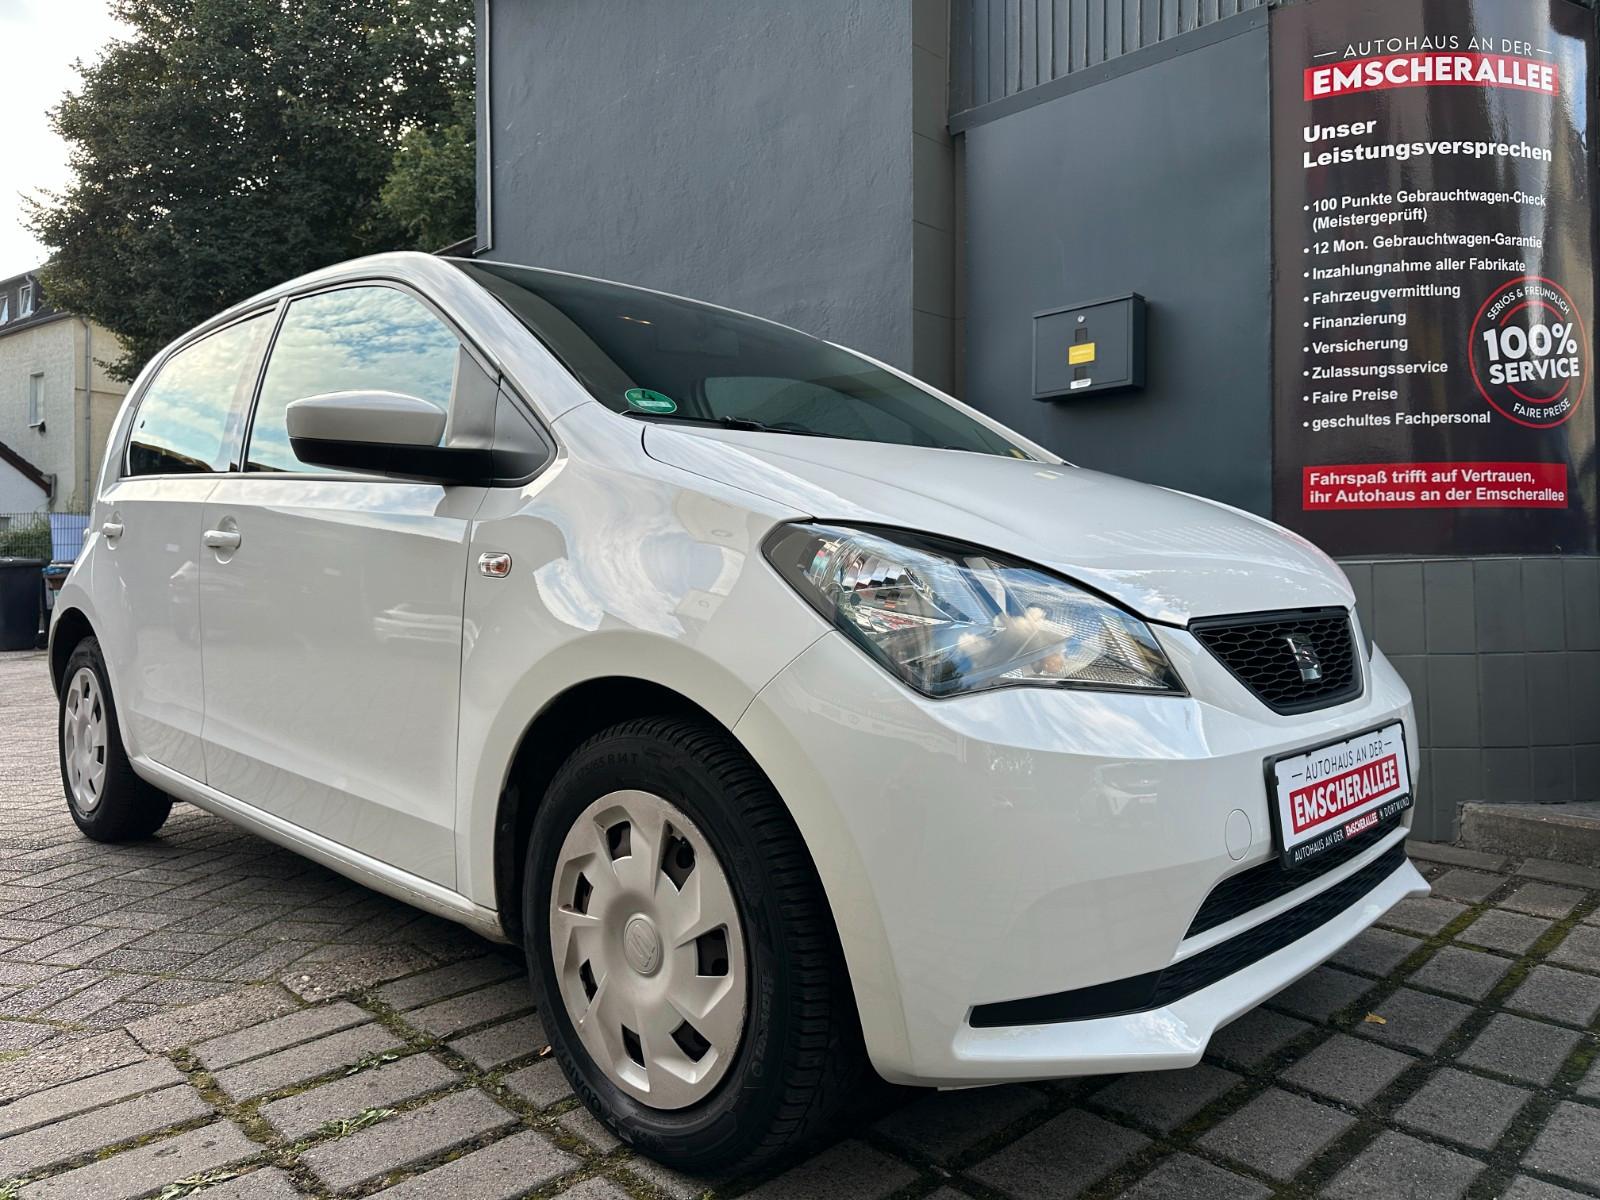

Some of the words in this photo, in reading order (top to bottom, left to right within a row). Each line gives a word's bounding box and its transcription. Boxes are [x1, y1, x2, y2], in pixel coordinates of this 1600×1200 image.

[1343, 35, 1459, 59] AUTOHAUS
[1468, 36, 1493, 52] AN
[1502, 39, 1532, 56] DER
[1313, 57, 1553, 95] EMSCHERALLEE
[1303, 120, 1377, 143] Unser
[1303, 138, 1552, 168] Leistungsversprechen
[1313, 198, 1338, 213] 100
[1342, 192, 1393, 209] Punkte
[1396, 188, 1546, 207] Gebrauchtwagen-Check
[1312, 207, 1428, 233] (Meistergeprüft)
[1313, 241, 1329, 255] 12
[1333, 238, 1369, 253] Mon.
[1373, 232, 1543, 249] Gebrauchtwagen-Garantie
[1313, 260, 1432, 280] Inzahlungnahme
[1435, 258, 1466, 271] aller
[1469, 257, 1526, 272] Fabrikate
[1313, 284, 1461, 305] Fahrzeugvermittlung
[1516, 288, 1524, 297] &
[1524, 286, 1570, 315] FREUNDLICH
[1313, 312, 1407, 330] Finanzierung
[1312, 337, 1408, 354] Versicherung
[1482, 322, 1578, 361] 100%
[1312, 360, 1448, 380] Zulassungsservice
[1489, 357, 1580, 385] SERVICE
[1313, 390, 1348, 404] Faire
[1352, 387, 1399, 402] Preise
[1513, 402, 1541, 418] FAIRE
[1543, 397, 1571, 418] PREISE
[1312, 412, 1391, 432] geschultes
[1395, 410, 1491, 427] Fachpersonal
[1310, 470, 1387, 488] Fahrspaß
[1392, 469, 1427, 484] trifft
[1431, 469, 1458, 483] auf
[1461, 469, 1535, 485] Vertrauen,
[1310, 490, 1333, 503] ihr
[1335, 488, 1416, 503] Autohaus
[1420, 490, 1441, 502] an
[1445, 487, 1471, 501] der
[1476, 487, 1564, 502] Emscherallee
[1305, 750, 1353, 782] AUTOHAUS
[1356, 746, 1367, 761] AN
[1369, 740, 1384, 758] DER
[1293, 759, 1398, 828] EMSCHERALLEE
[1294, 838, 1325, 863] AUTOHAUS
[1325, 833, 1333, 847] AN
[1334, 828, 1344, 843] DER
[1383, 796, 1410, 817] DORTMUND
